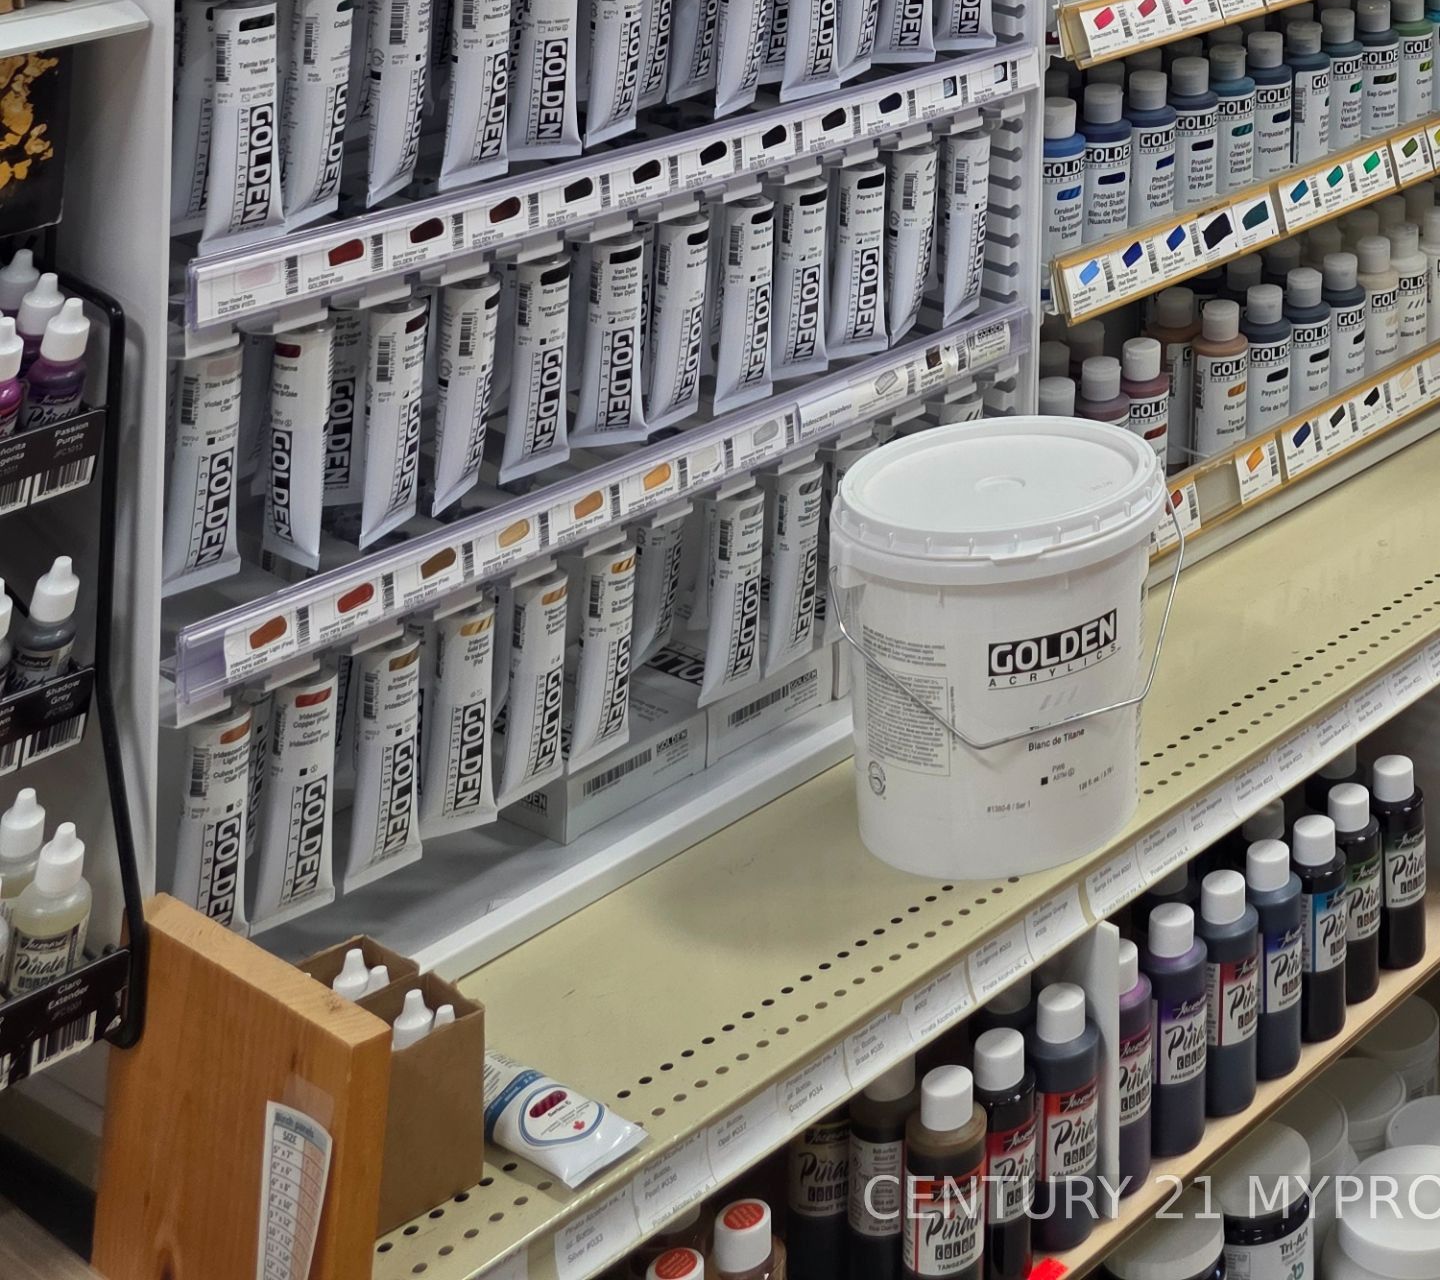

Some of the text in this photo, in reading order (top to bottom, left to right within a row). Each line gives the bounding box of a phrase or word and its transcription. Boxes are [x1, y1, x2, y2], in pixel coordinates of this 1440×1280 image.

[537, 38, 569, 143] GOLDEN
[240, 102, 273, 225] GOLDEN
[1085, 146, 1131, 163] GOLDE
[854, 246, 880, 338] GOLDEN
[532, 347, 563, 453] GOLDEN
[607, 328, 634, 426] GOLDEN
[54, 421, 89, 438] Passion
[56, 431, 85, 448] Purple
[194, 448, 234, 569] GOLDEN
[988, 608, 1117, 677] GOLDEN
[988, 644, 1118, 688] ACRYLICS
[44, 677, 81, 699] Shadow
[51, 691, 72, 706] Grey
[454, 697, 486, 811] GOLDEN
[1065, 727, 1085, 743] Titane
[292, 774, 326, 905] GOLDEN
[48, 985, 90, 1011] Extender
[57, 978, 82, 995] Claro
